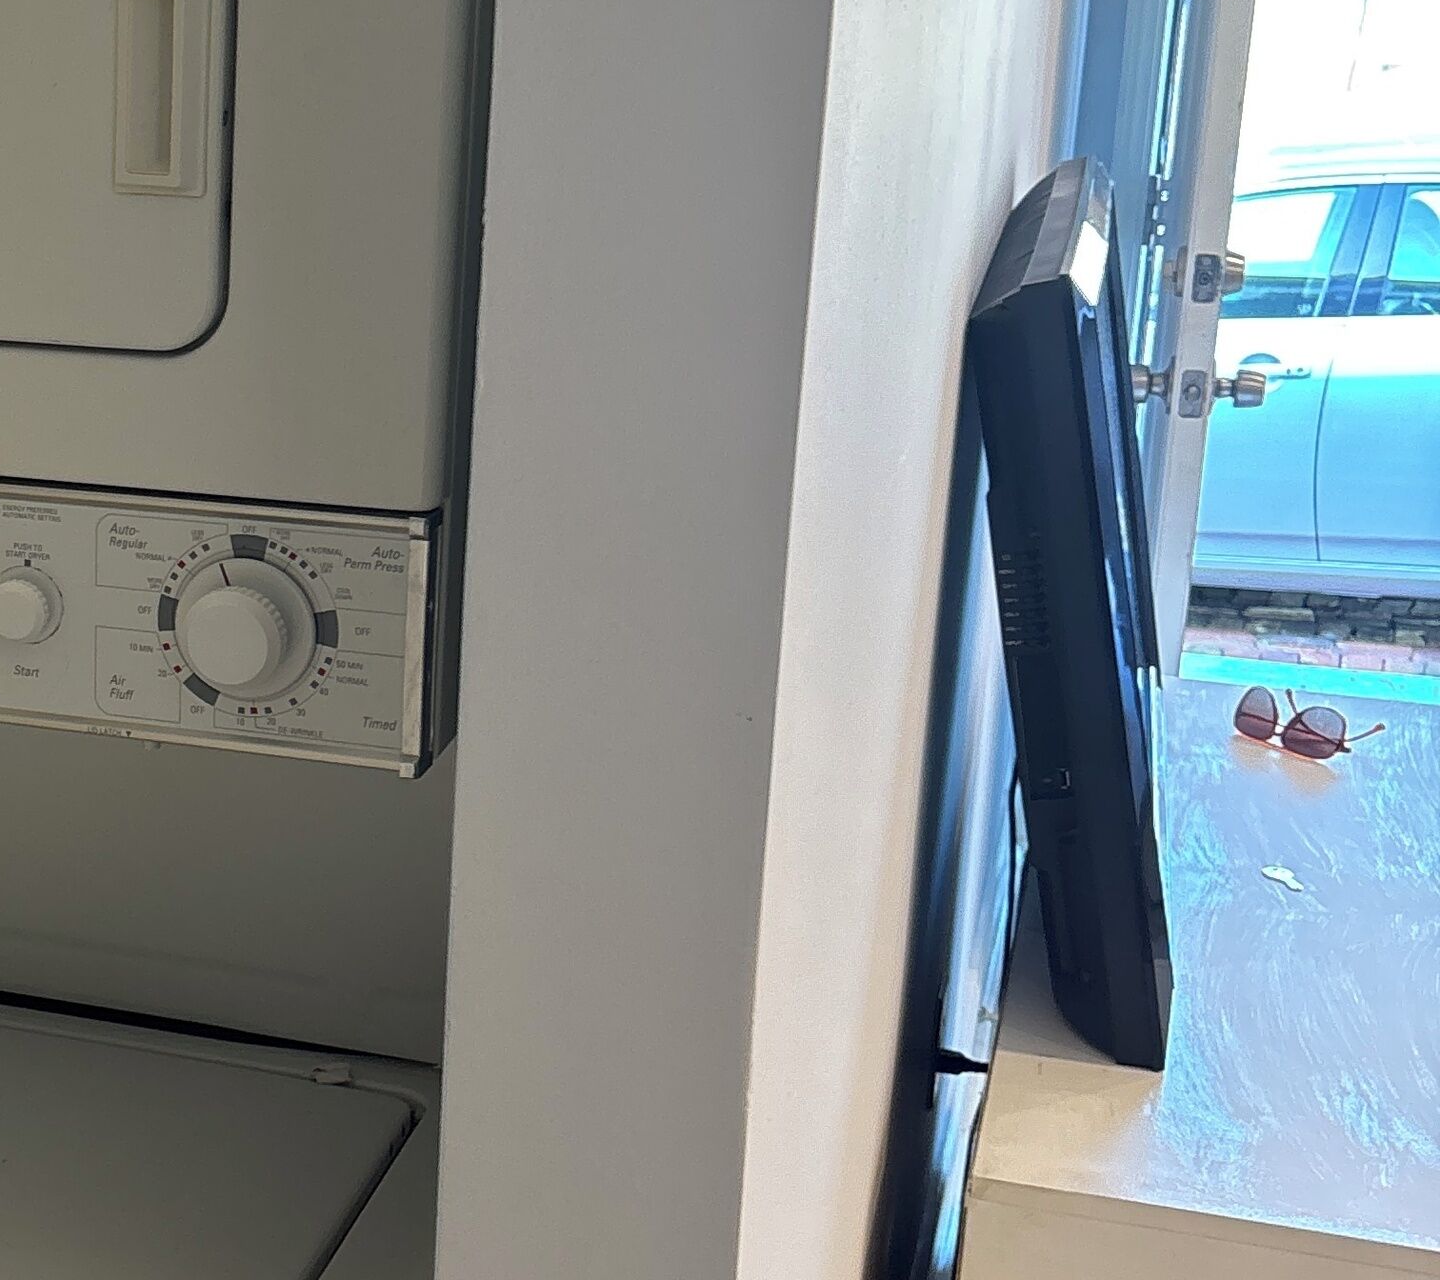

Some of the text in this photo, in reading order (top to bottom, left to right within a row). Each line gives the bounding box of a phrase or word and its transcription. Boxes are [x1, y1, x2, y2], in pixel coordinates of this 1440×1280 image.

[108, 522, 140, 536] Auto-
[241, 524, 257, 534] OFF
[13, 542, 43, 552] PUSH TO
[108, 536, 148, 550] Regular
[5, 549, 26, 558] START
[135, 552, 166, 562] NORMAL
[311, 547, 344, 558] NORMAL
[371, 545, 405, 560] Auto-
[343, 556, 405, 574] Perm Press
[137, 604, 152, 615] OFF
[354, 626, 371, 636] OFF
[129, 642, 154, 653] 10 MIN
[13, 663, 39, 678] Start
[346, 661, 363, 670] MIN
[109, 674, 127, 686] Air
[335, 675, 369, 687] NORMAL
[109, 688, 135, 701] Fluff
[189, 705, 205, 714] OFF
[361, 716, 398, 732] Timed
